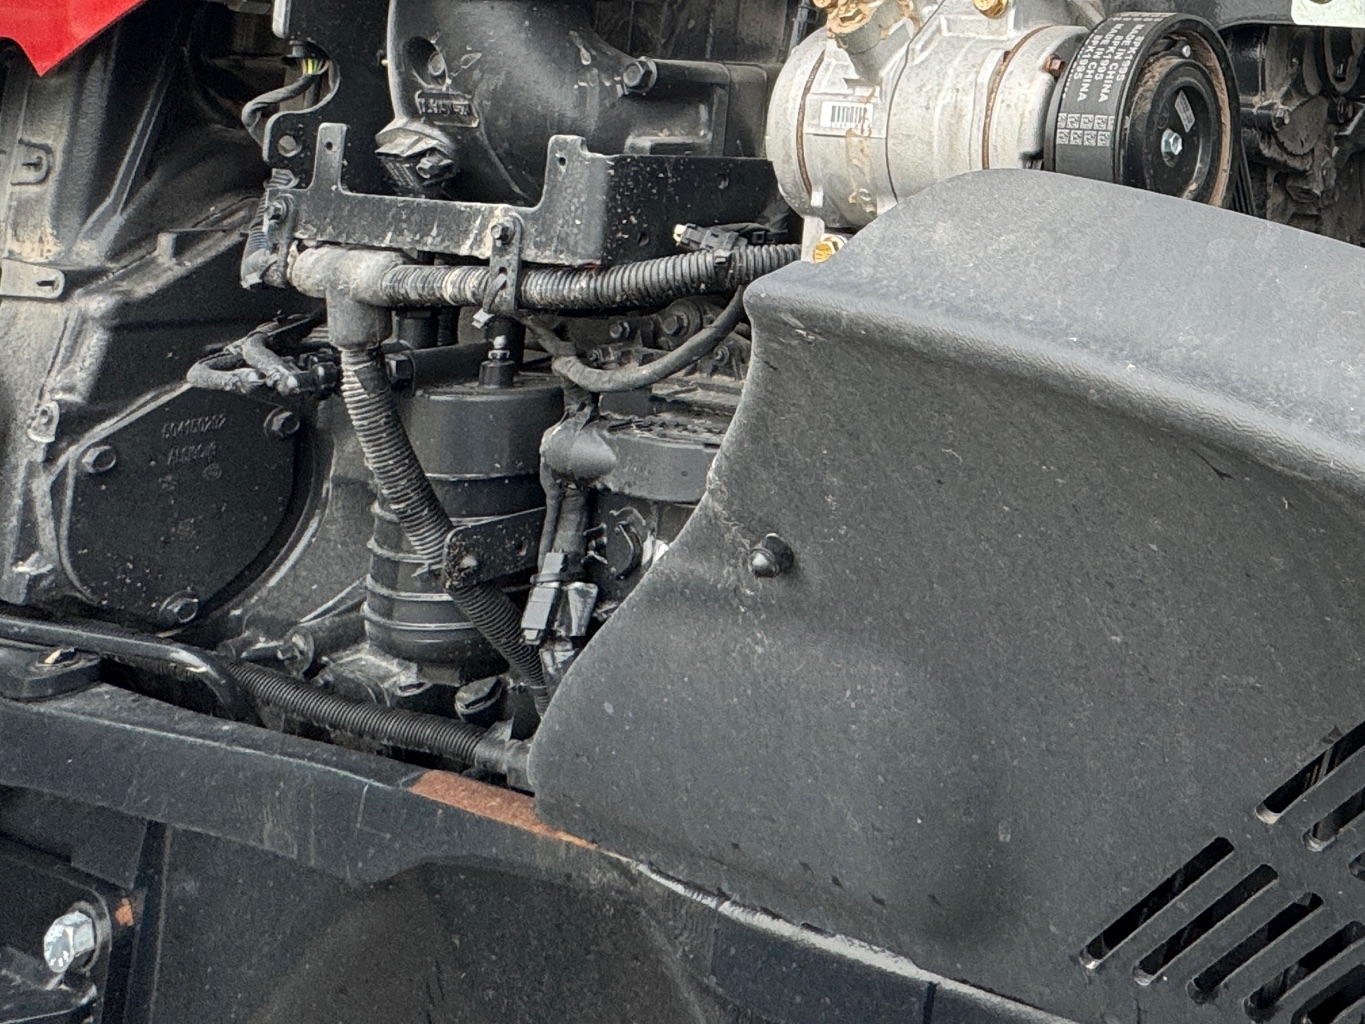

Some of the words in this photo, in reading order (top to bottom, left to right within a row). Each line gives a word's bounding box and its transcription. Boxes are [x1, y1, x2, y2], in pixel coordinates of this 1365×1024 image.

[1092, 47, 1106, 59] IN
[1099, 23, 1125, 46] MADE
[1114, 48, 1127, 60] IN
[1121, 23, 1146, 46] MADE
[1073, 35, 1103, 80] 8PK1995
[1094, 35, 1124, 81] 8PK1995
[1116, 36, 1145, 82] 8PK1995
[1077, 62, 1097, 102] CHINA
[1098, 63, 1119, 103] CHINA
